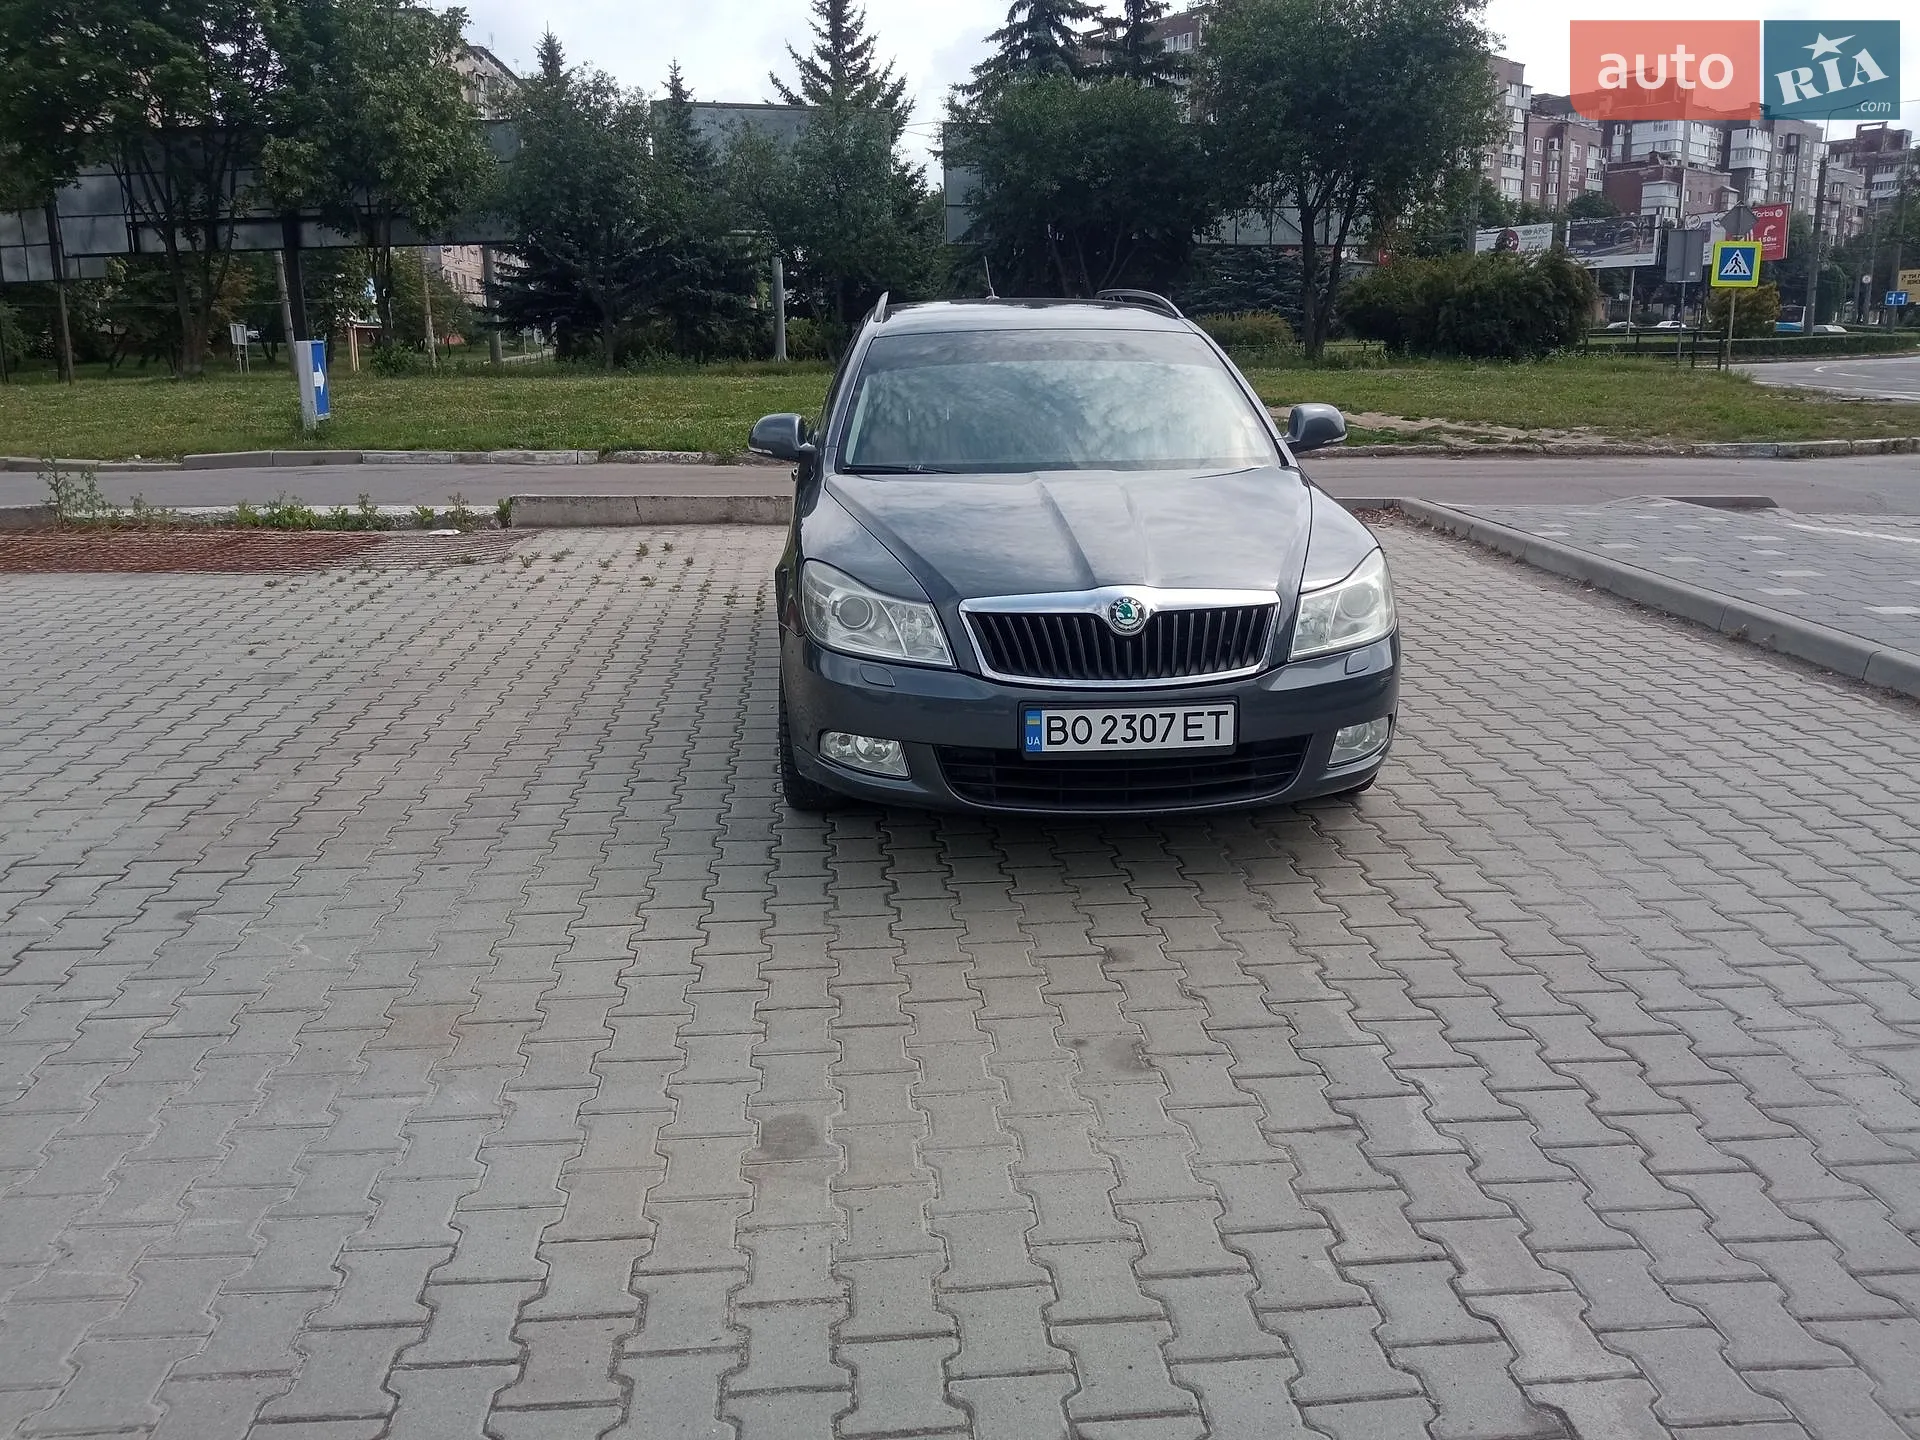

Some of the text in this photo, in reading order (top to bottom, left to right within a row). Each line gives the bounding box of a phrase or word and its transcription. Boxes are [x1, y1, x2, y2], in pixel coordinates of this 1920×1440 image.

[1046, 710, 1229, 746] BO 2307 ET
[1026, 736, 1041, 746] UA
